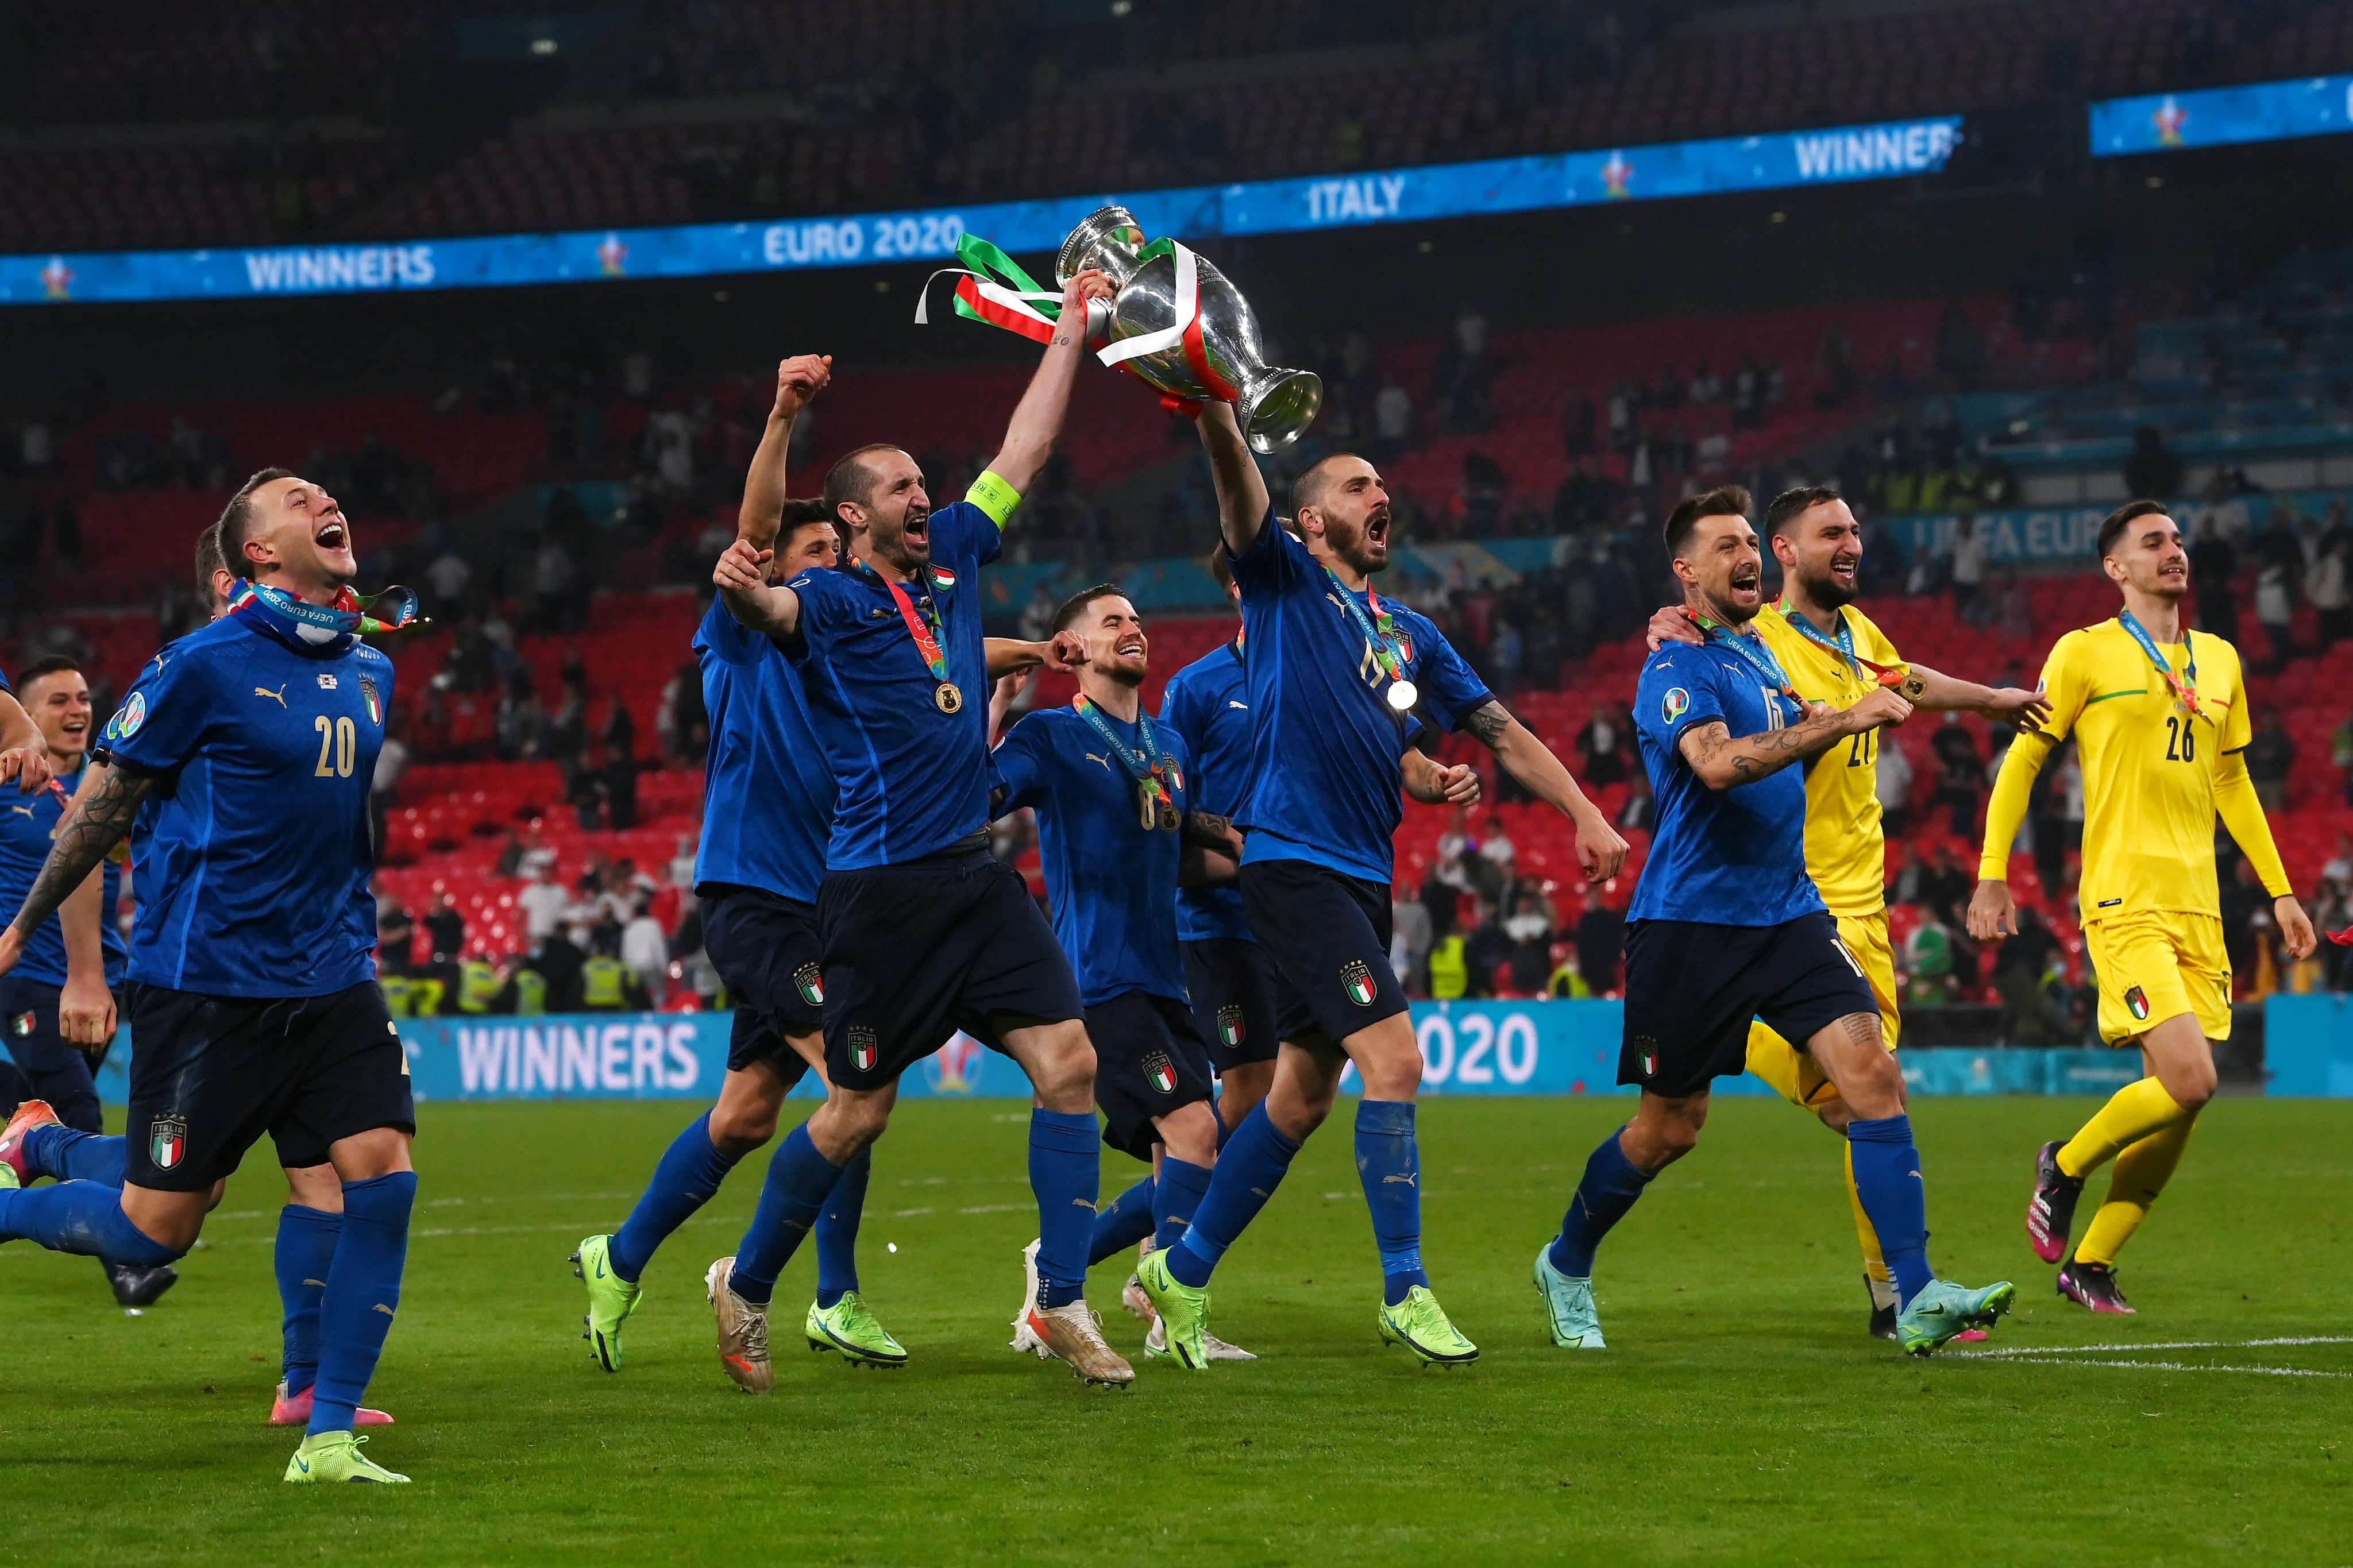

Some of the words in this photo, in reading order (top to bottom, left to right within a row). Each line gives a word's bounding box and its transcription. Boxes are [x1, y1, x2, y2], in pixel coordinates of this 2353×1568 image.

[1795, 123, 1964, 179] WINNER
[1309, 175, 1405, 221] ITALY
[763, 221, 862, 264] EURO
[873, 215, 965, 257] 2020
[246, 245, 435, 291] WINNERS
[263, 589, 282, 605] 2020
[1333, 581, 1348, 598] 2020
[280, 600, 308, 619] EURO
[308, 610, 334, 624] UEFA
[1346, 598, 1363, 618] EURO
[1360, 616, 1374, 636] UEFA
[1803, 625, 1820, 643] UEFA
[1842, 638, 1852, 658] UEFA
[1727, 638, 1744, 655] UEFA
[1743, 650, 1761, 667] EURO
[1760, 663, 1777, 680] 2020
[1761, 686, 1785, 732] 15
[1092, 716, 1108, 733] 2020
[315, 715, 355, 778] 20
[1105, 731, 1123, 749] EURO
[1140, 721, 1150, 740] EURO
[1145, 739, 1156, 756] 2020
[2166, 716, 2194, 762] 26
[1120, 747, 1136, 764] UEFA
[798, 969, 819, 985] ITALIA
[1344, 968, 1366, 983] ITALIA
[1220, 1012, 1240, 1023] ITALIA
[460, 1023, 699, 1093] WINNERS
[1417, 1013, 1538, 1085] 020
[1145, 1057, 1167, 1071] ITALIA
[155, 1125, 183, 1134] ITALIA
